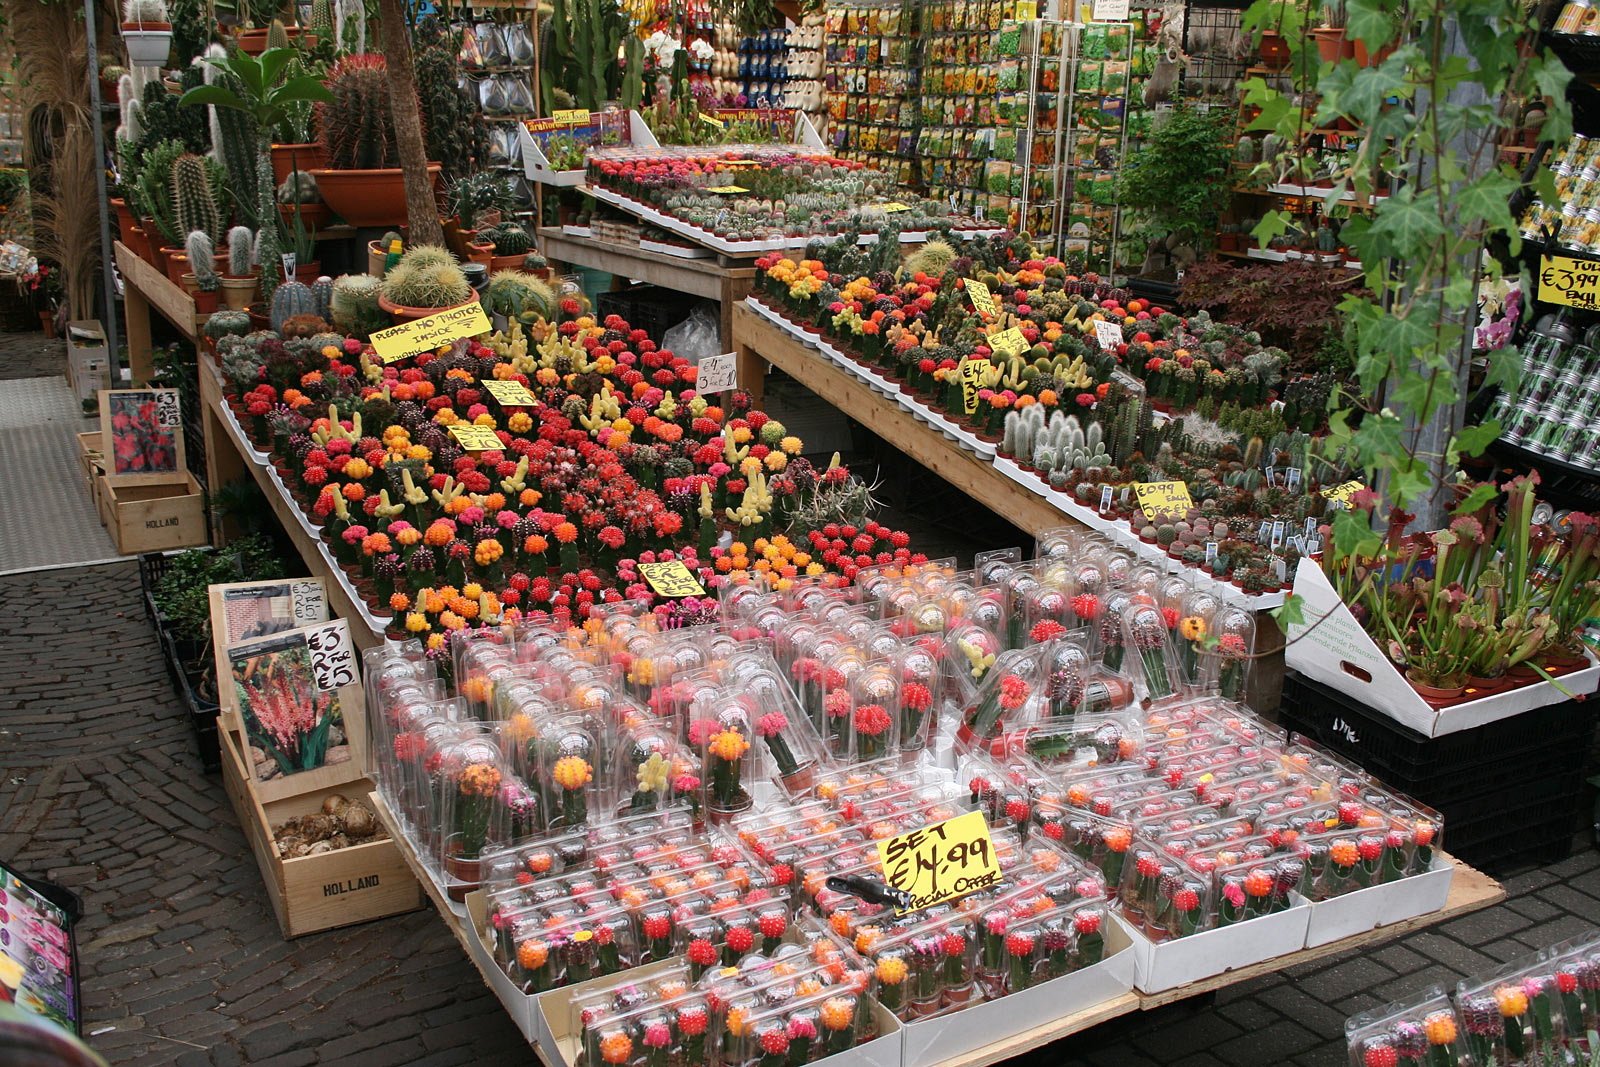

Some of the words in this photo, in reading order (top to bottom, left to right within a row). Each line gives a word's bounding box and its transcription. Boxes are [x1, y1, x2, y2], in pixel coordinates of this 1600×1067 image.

[375, 324, 412, 341] PLEASE
[416, 319, 435, 330] NO
[412, 326, 453, 343] INSIDE
[431, 337, 457, 348] YOU
[699, 376, 708, 389] 3
[1142, 503, 1155, 518] 5
[145, 516, 179, 529] HOLLAND
[313, 652, 331, 673] 2
[328, 651, 351, 664] FOR
[886, 822, 947, 864] SET
[323, 874, 380, 897] HOLLAND
[899, 889, 953, 914] PECIAL
[953, 870, 1003, 892] OFFER
